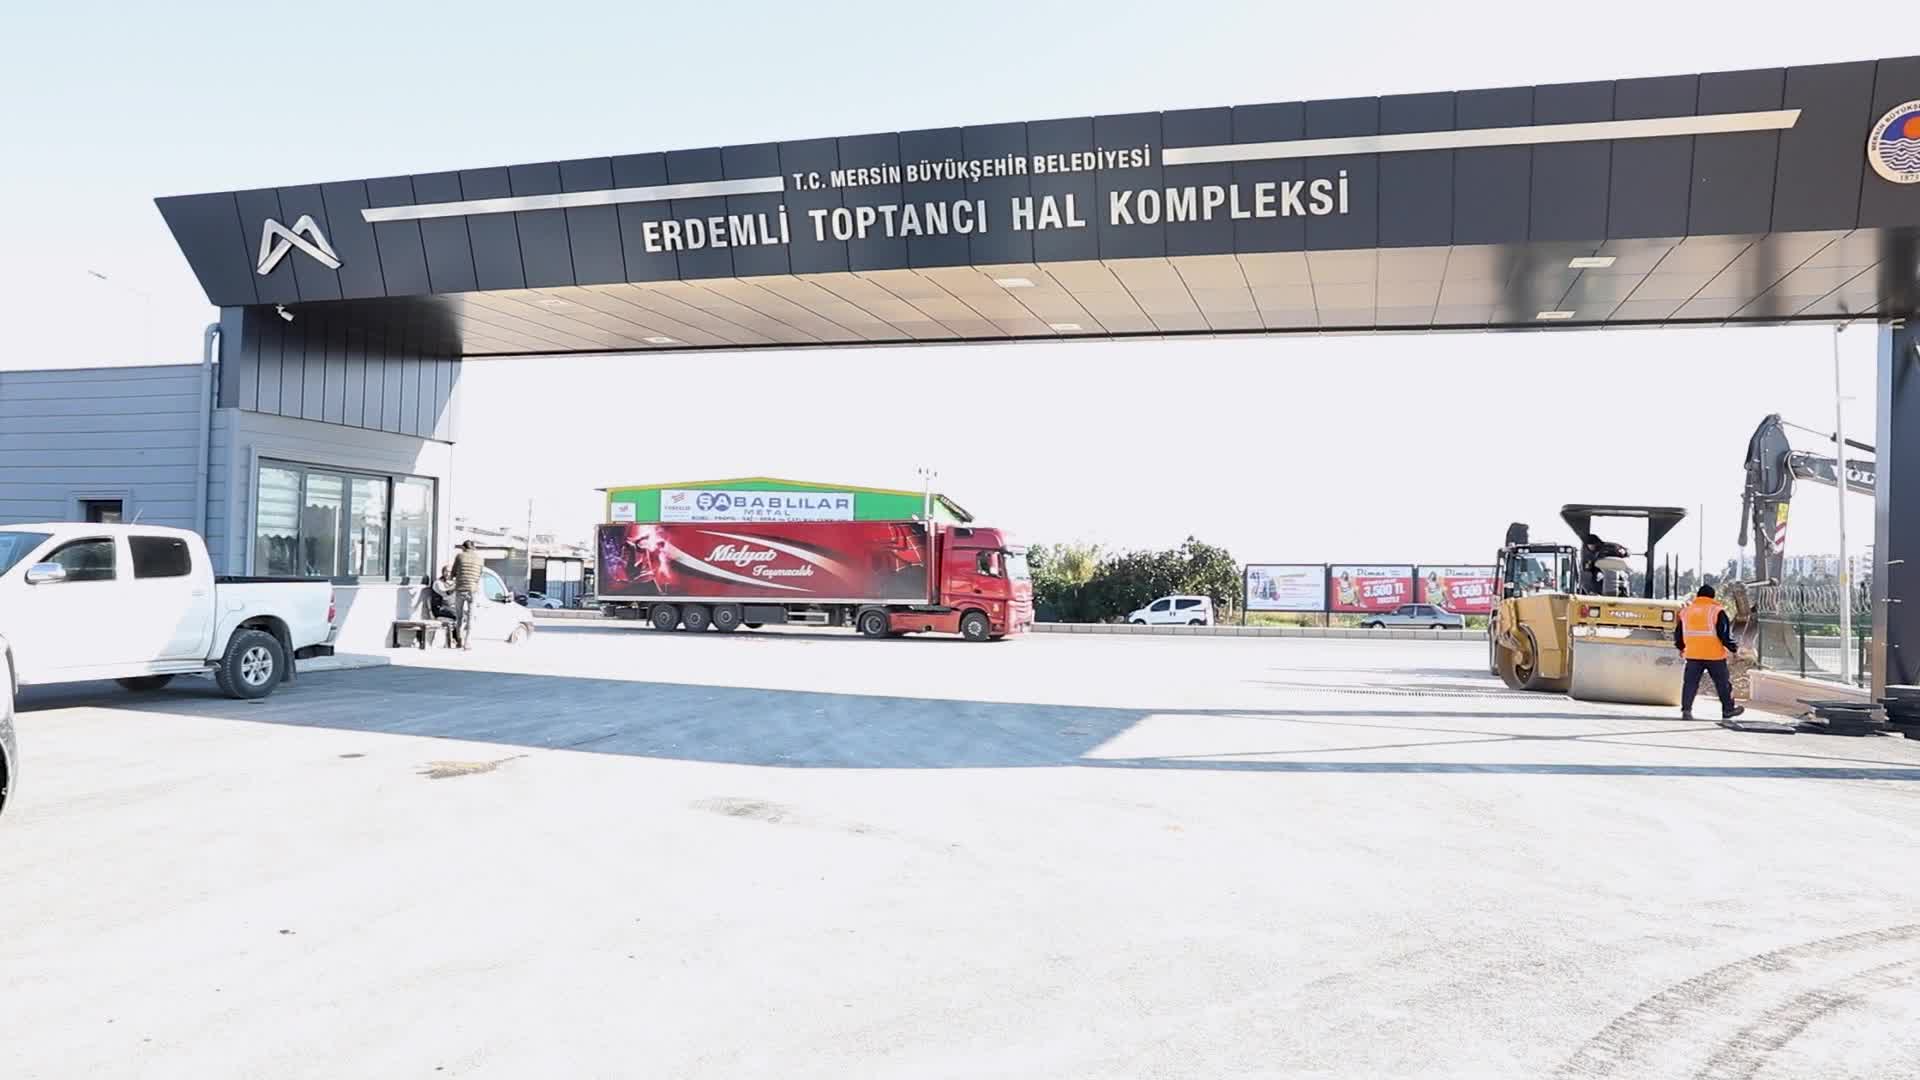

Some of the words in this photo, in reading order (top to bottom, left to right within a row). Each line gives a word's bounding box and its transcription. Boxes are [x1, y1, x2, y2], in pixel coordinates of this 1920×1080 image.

[793, 171, 827, 192] T.C.
[830, 162, 901, 188] MERSİN
[906, 153, 1028, 184] BÜYÜKŞEHİR
[1033, 143, 1152, 174] BELEDİYESİ
[642, 204, 790, 253] ERDEMLİ
[808, 199, 988, 242] TOPTANCI
[1011, 193, 1087, 232] HAL
[1110, 169, 1350, 226] KOMPLEKSİ
[734, 497, 849, 510] BABLILAR
[743, 509, 791, 517] METAL
[704, 544, 777, 567] Midyat
